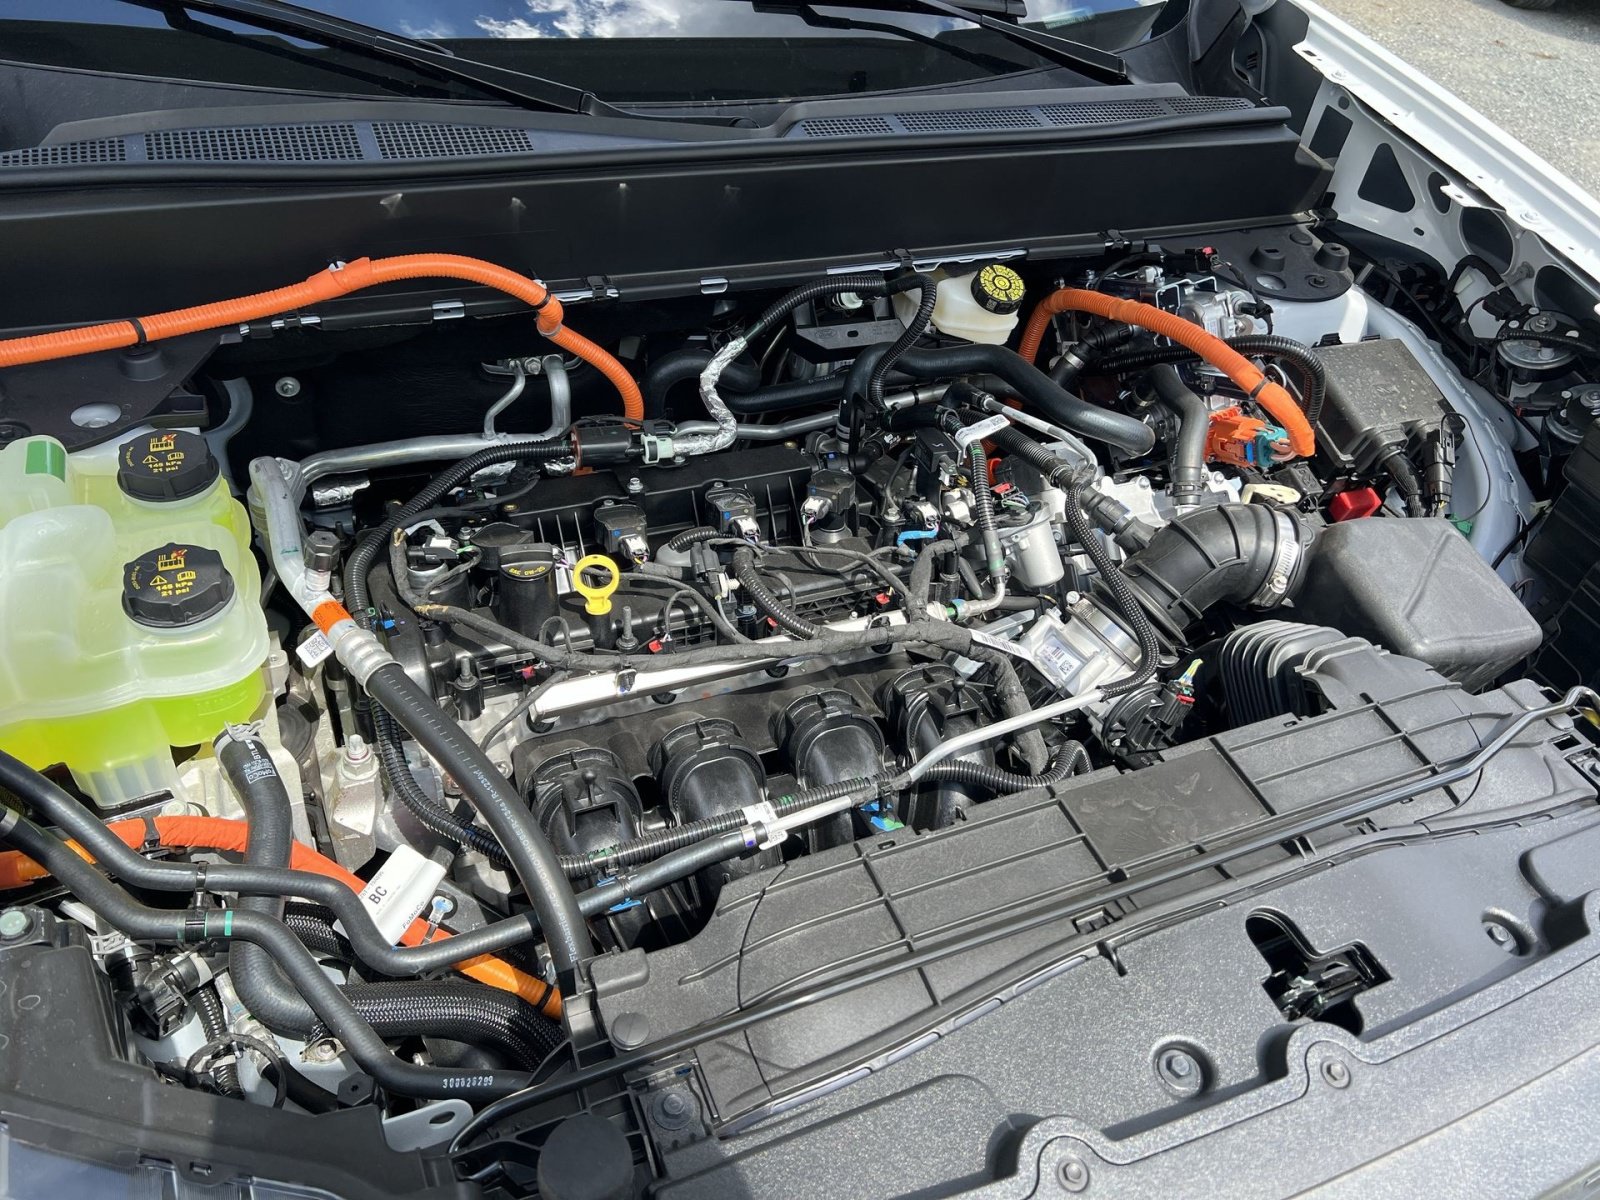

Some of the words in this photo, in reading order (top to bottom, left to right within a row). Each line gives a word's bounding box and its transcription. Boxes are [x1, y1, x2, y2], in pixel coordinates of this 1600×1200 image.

[175, 587, 190, 595] psi
[368, 886, 388, 905] BC
[402, 901, 425, 930] FoMoCo
